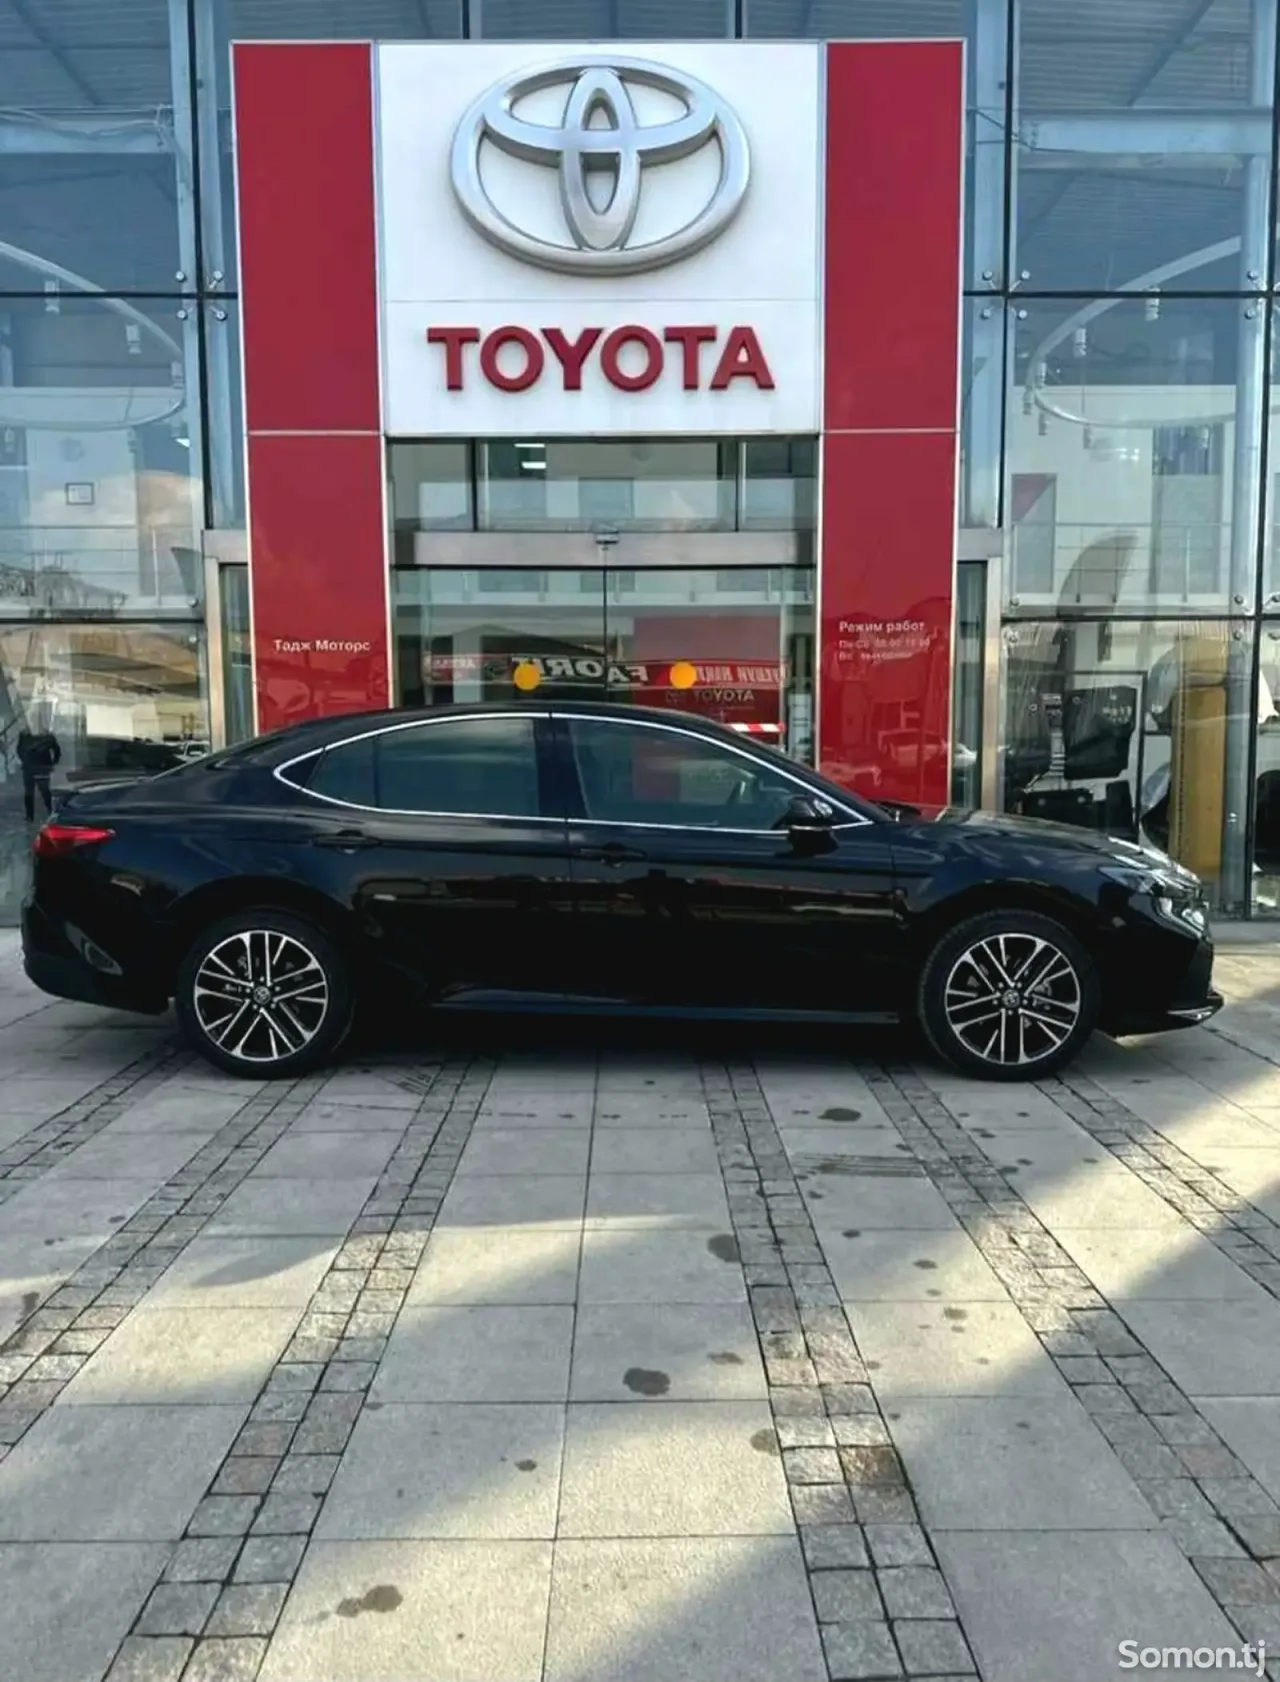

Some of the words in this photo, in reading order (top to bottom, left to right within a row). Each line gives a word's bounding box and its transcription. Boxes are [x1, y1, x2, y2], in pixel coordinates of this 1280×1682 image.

[427, 325, 775, 392] TOYOTA
[839, 620, 883, 633] Режим
[273, 639, 311, 652] Тадж
[315, 639, 371, 653] Моторс
[694, 689, 754, 702] TOYOTA
